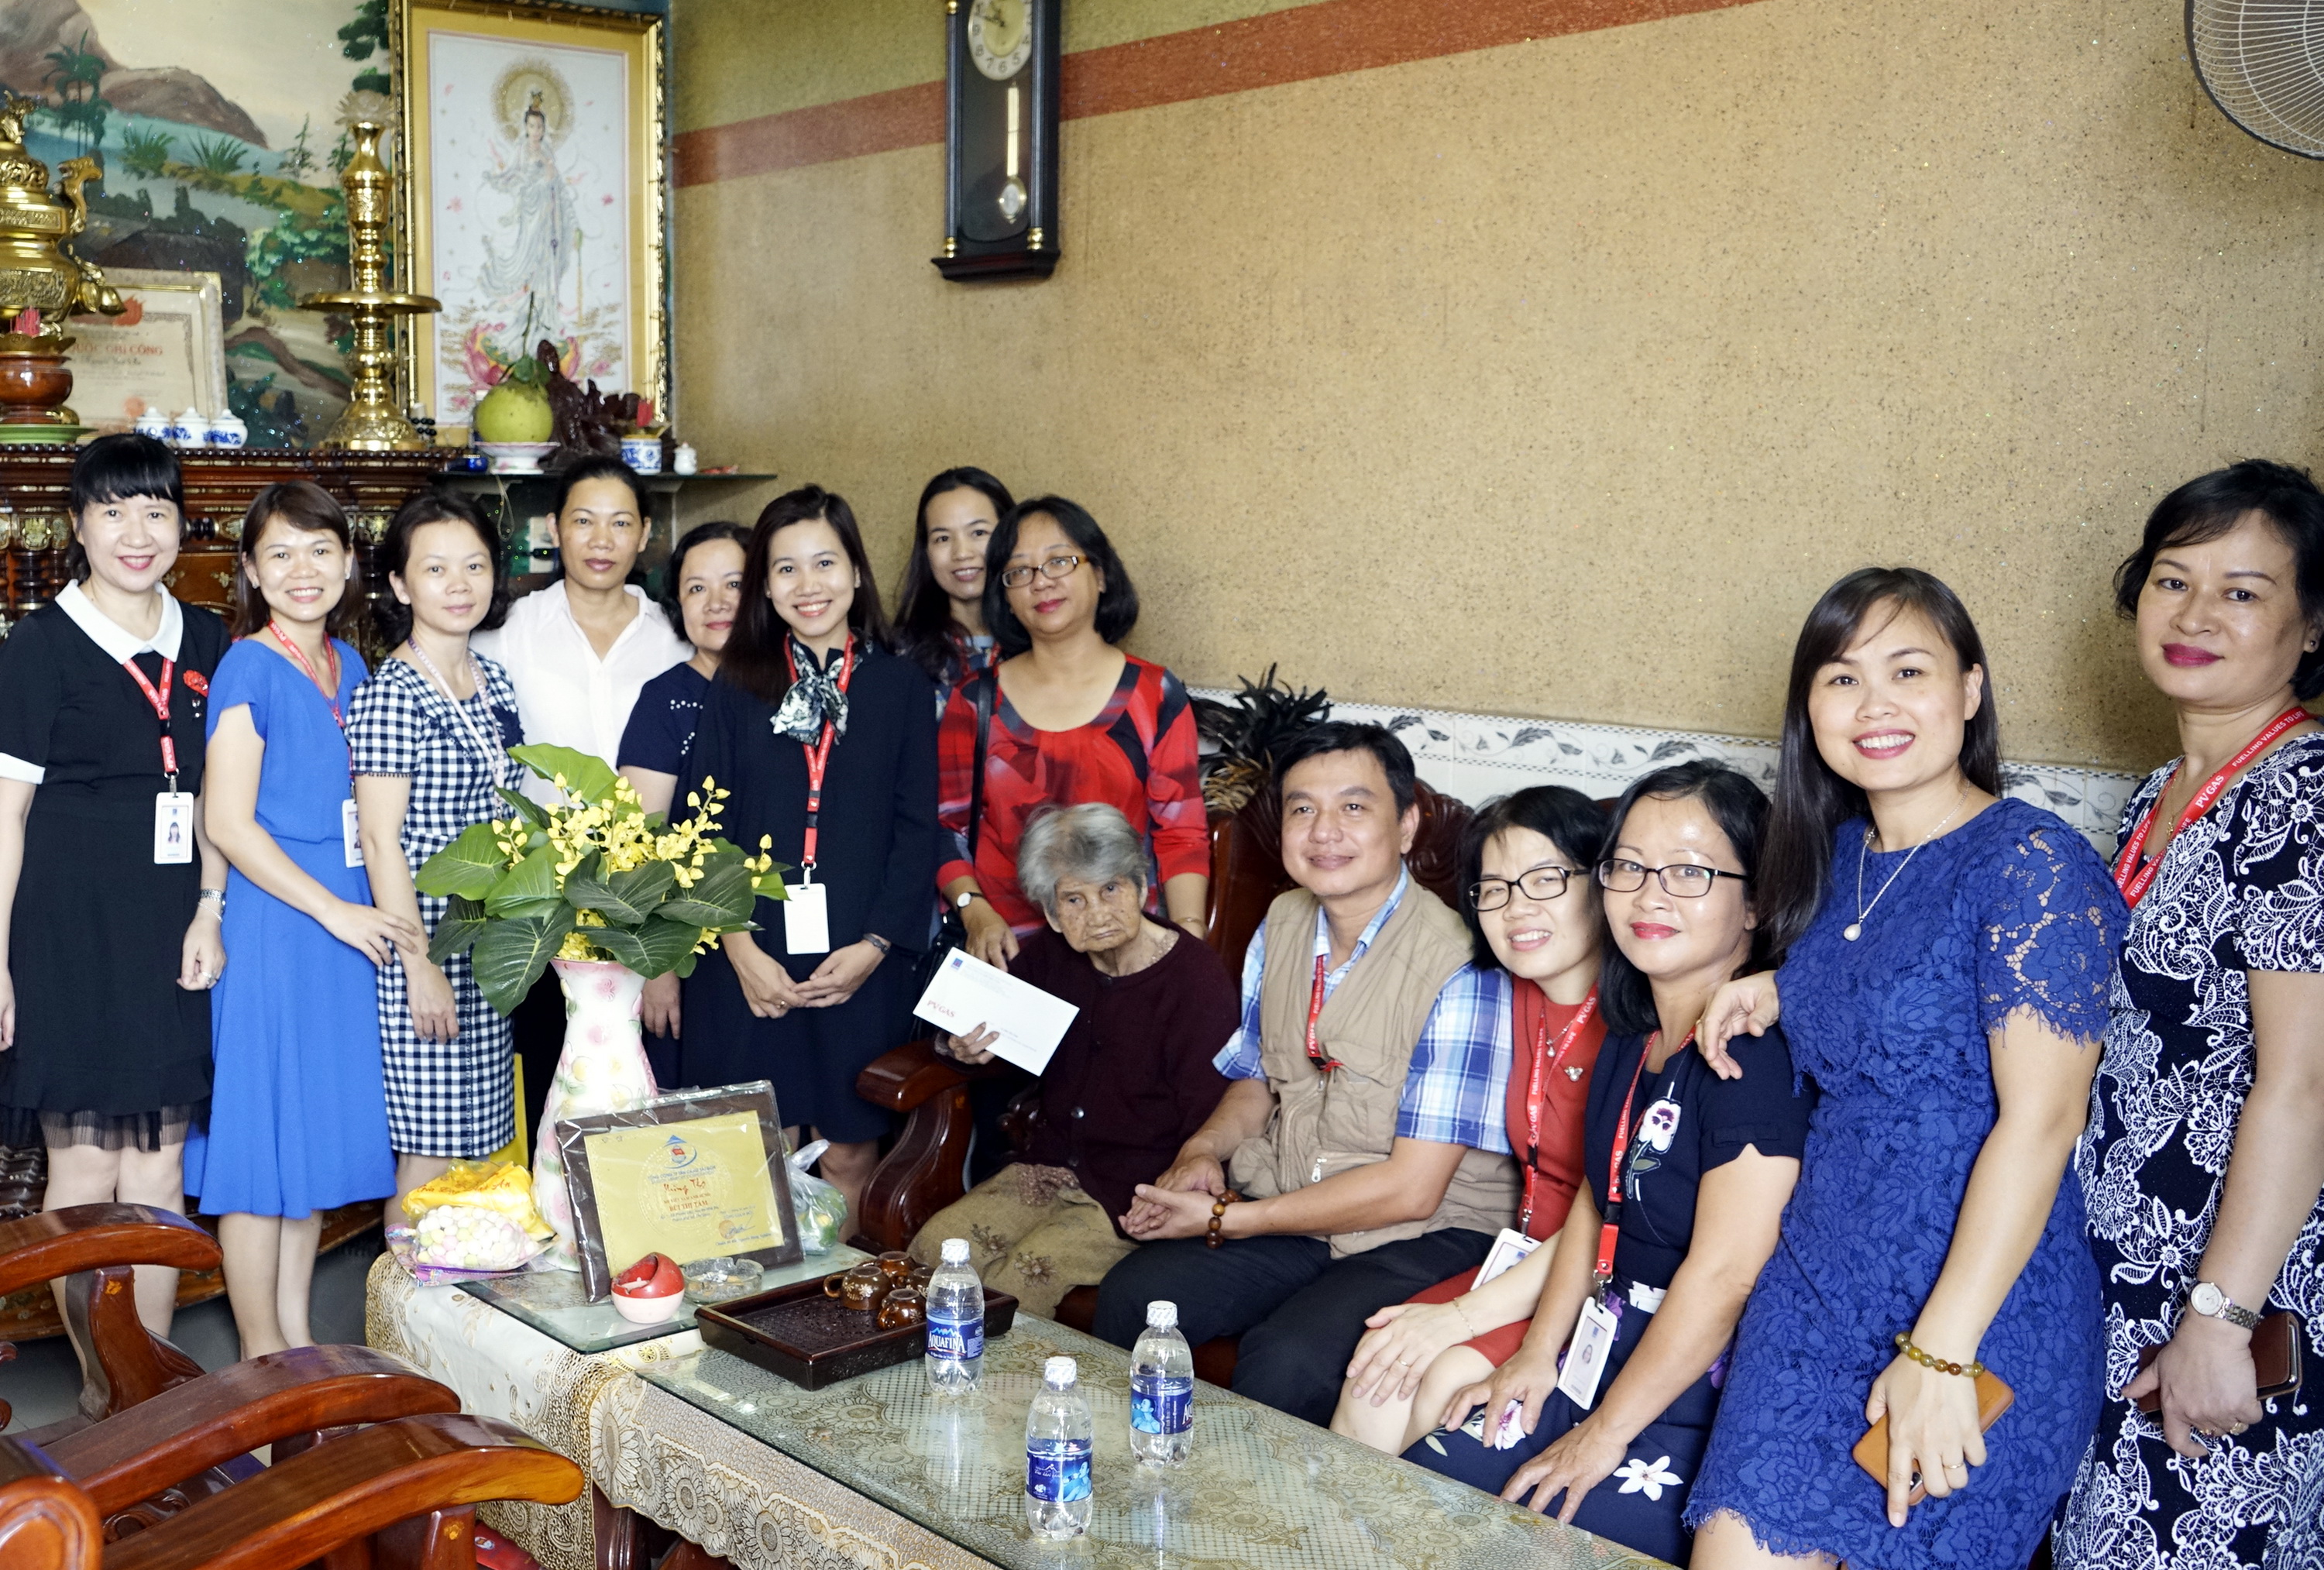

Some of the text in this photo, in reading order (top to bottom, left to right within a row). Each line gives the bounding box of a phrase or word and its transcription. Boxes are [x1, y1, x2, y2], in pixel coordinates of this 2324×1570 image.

[2232, 710, 2305, 768] FUELLING VALUES TO LIFE
[2117, 819, 2152, 889] UELLING VALUES TO LIFE
[2130, 867, 2154, 898] FUELLING
[1531, 1068, 1540, 1095] FUELLING
[1618, 1109, 1628, 1139] FUELLING
[928, 1330, 968, 1354] AQUAFINA
